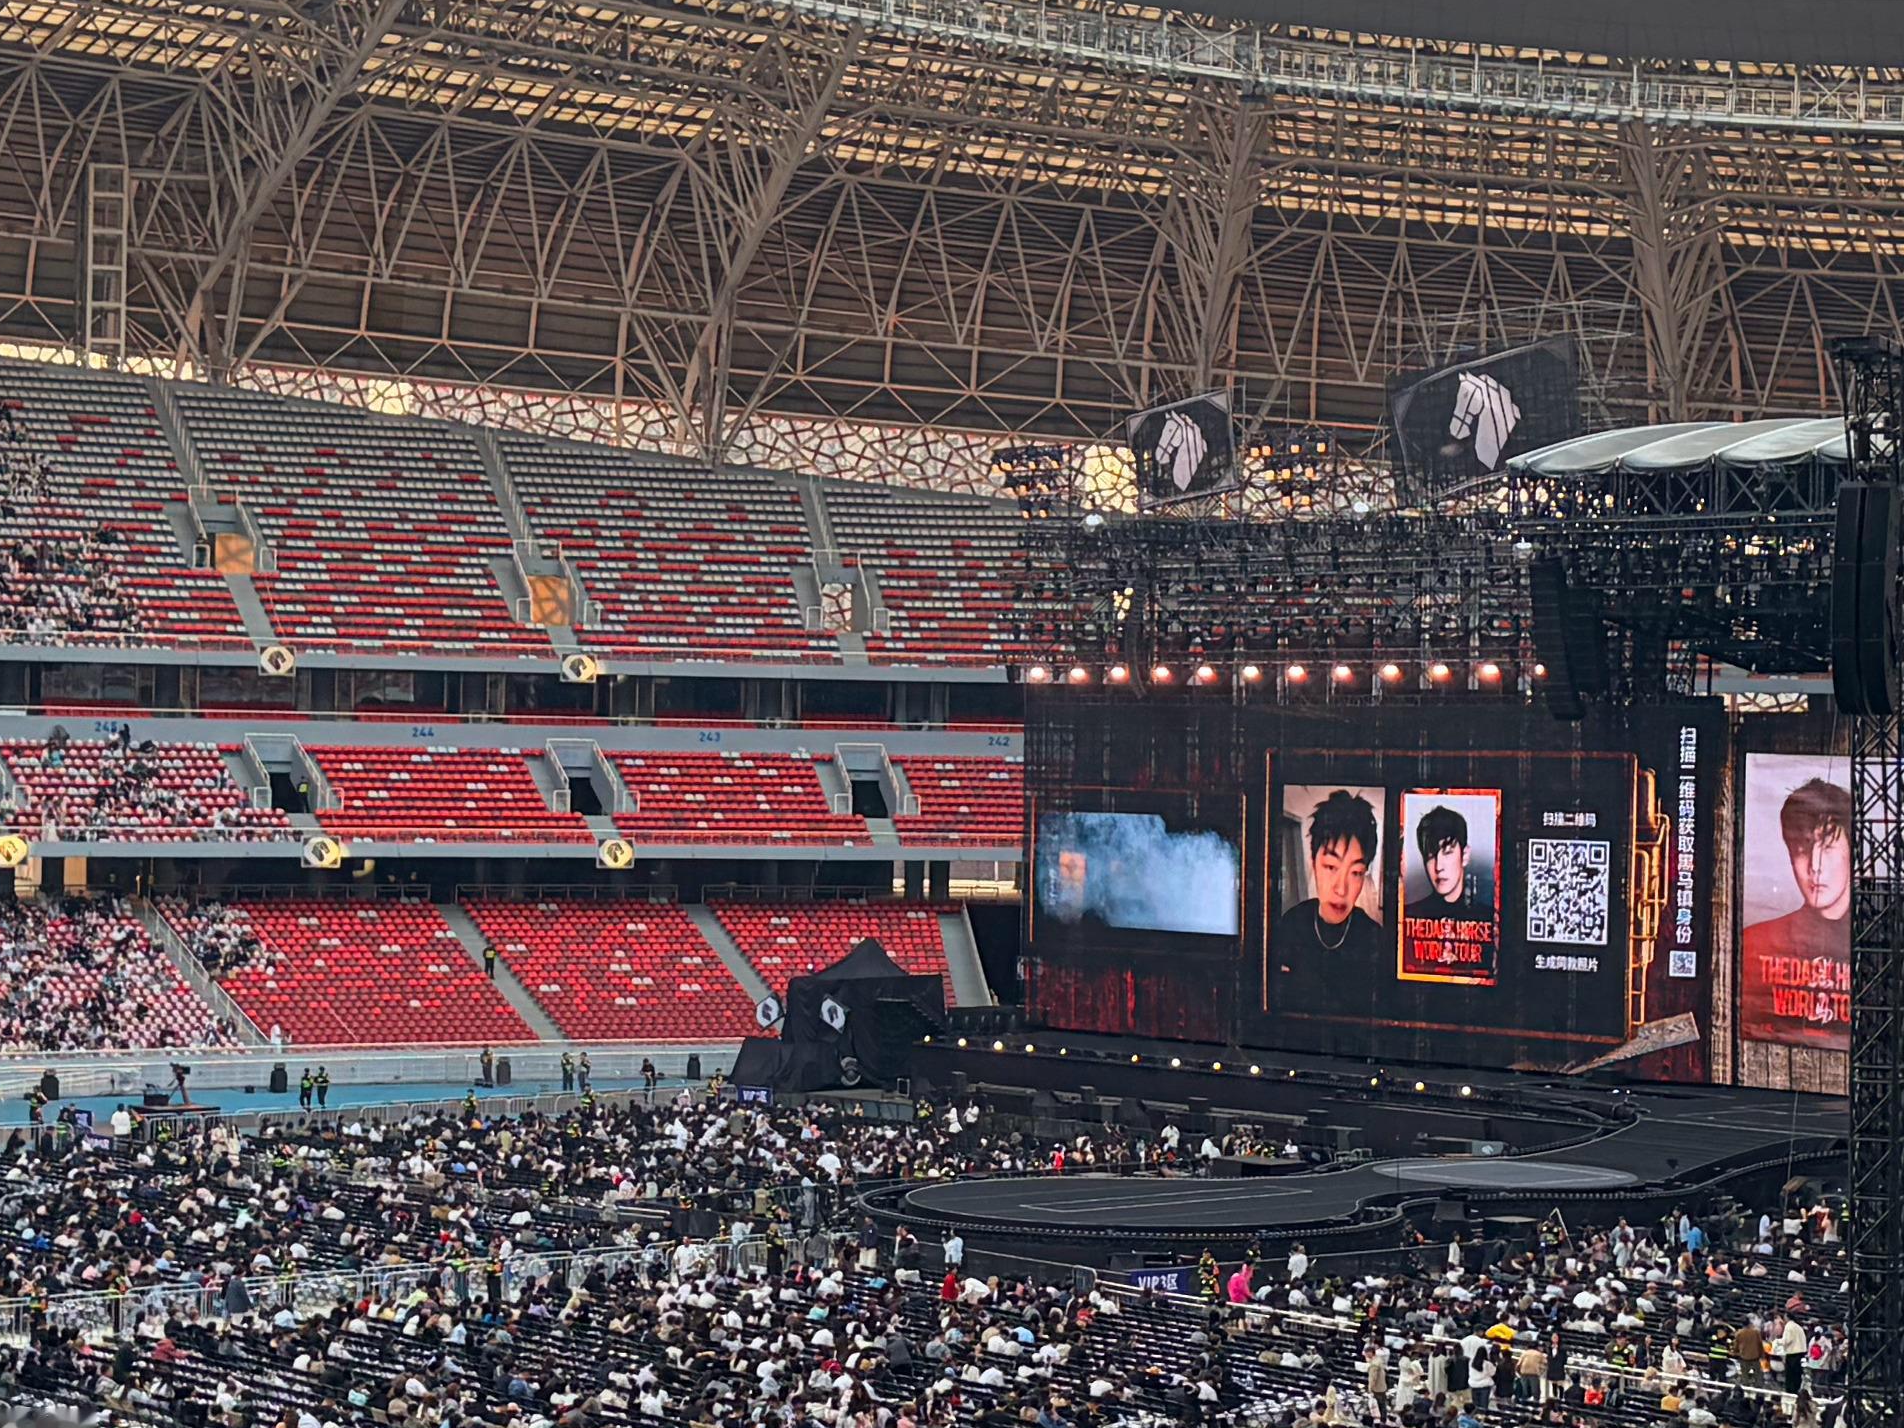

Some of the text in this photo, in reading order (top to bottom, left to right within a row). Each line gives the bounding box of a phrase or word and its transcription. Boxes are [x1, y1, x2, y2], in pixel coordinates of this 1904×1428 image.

[412, 726, 435, 738] 244
[698, 731, 721, 743] 243
[987, 735, 1011, 747] 242
